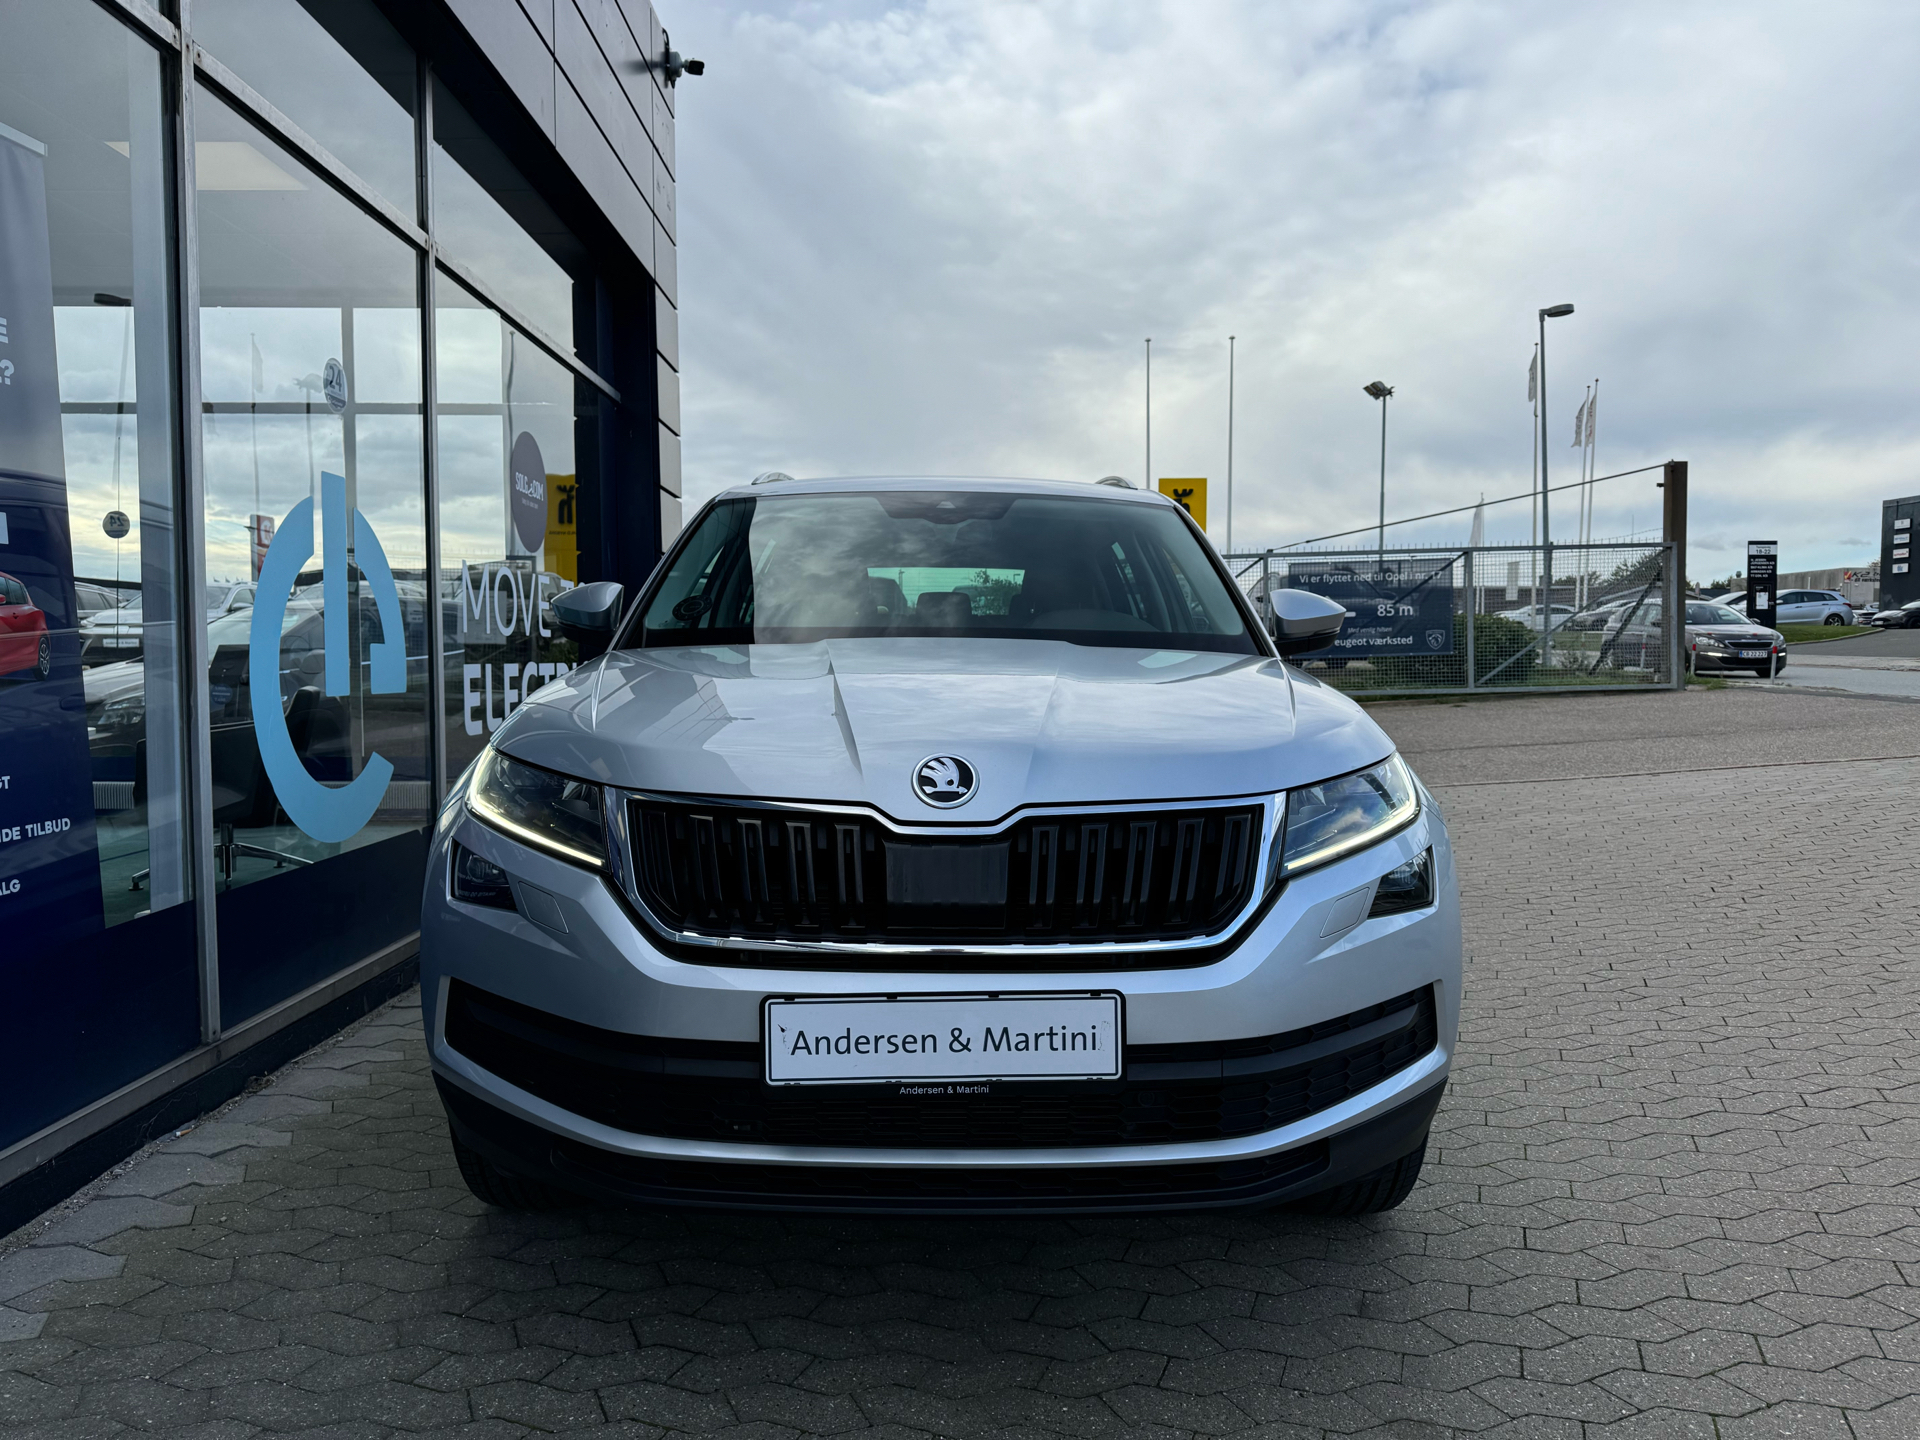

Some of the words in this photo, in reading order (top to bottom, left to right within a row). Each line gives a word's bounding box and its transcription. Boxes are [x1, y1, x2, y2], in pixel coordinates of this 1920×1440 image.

[1299, 574, 1309, 584] Vi
[1311, 575, 1320, 584] er
[1322, 572, 1352, 585] flyttet
[1353, 573, 1371, 583] ned
[1374, 572, 1384, 582] til
[1385, 571, 1408, 584] Opel
[462, 559, 552, 638] MOVE
[1377, 604, 1395, 617] 85
[1399, 605, 1414, 617] m
[1334, 636, 1367, 649] eugeot
[1368, 635, 1413, 647] værksted
[0, 826, 21, 843] DE
[25, 817, 71, 838] TILBUD
[790, 1027, 938, 1056] Andersen
[948, 1027, 972, 1054] &
[983, 1025, 1098, 1053] Martini
[899, 1085, 944, 1095] Andersen
[947, 1085, 954, 1094] &
[956, 1084, 990, 1095] Martini
